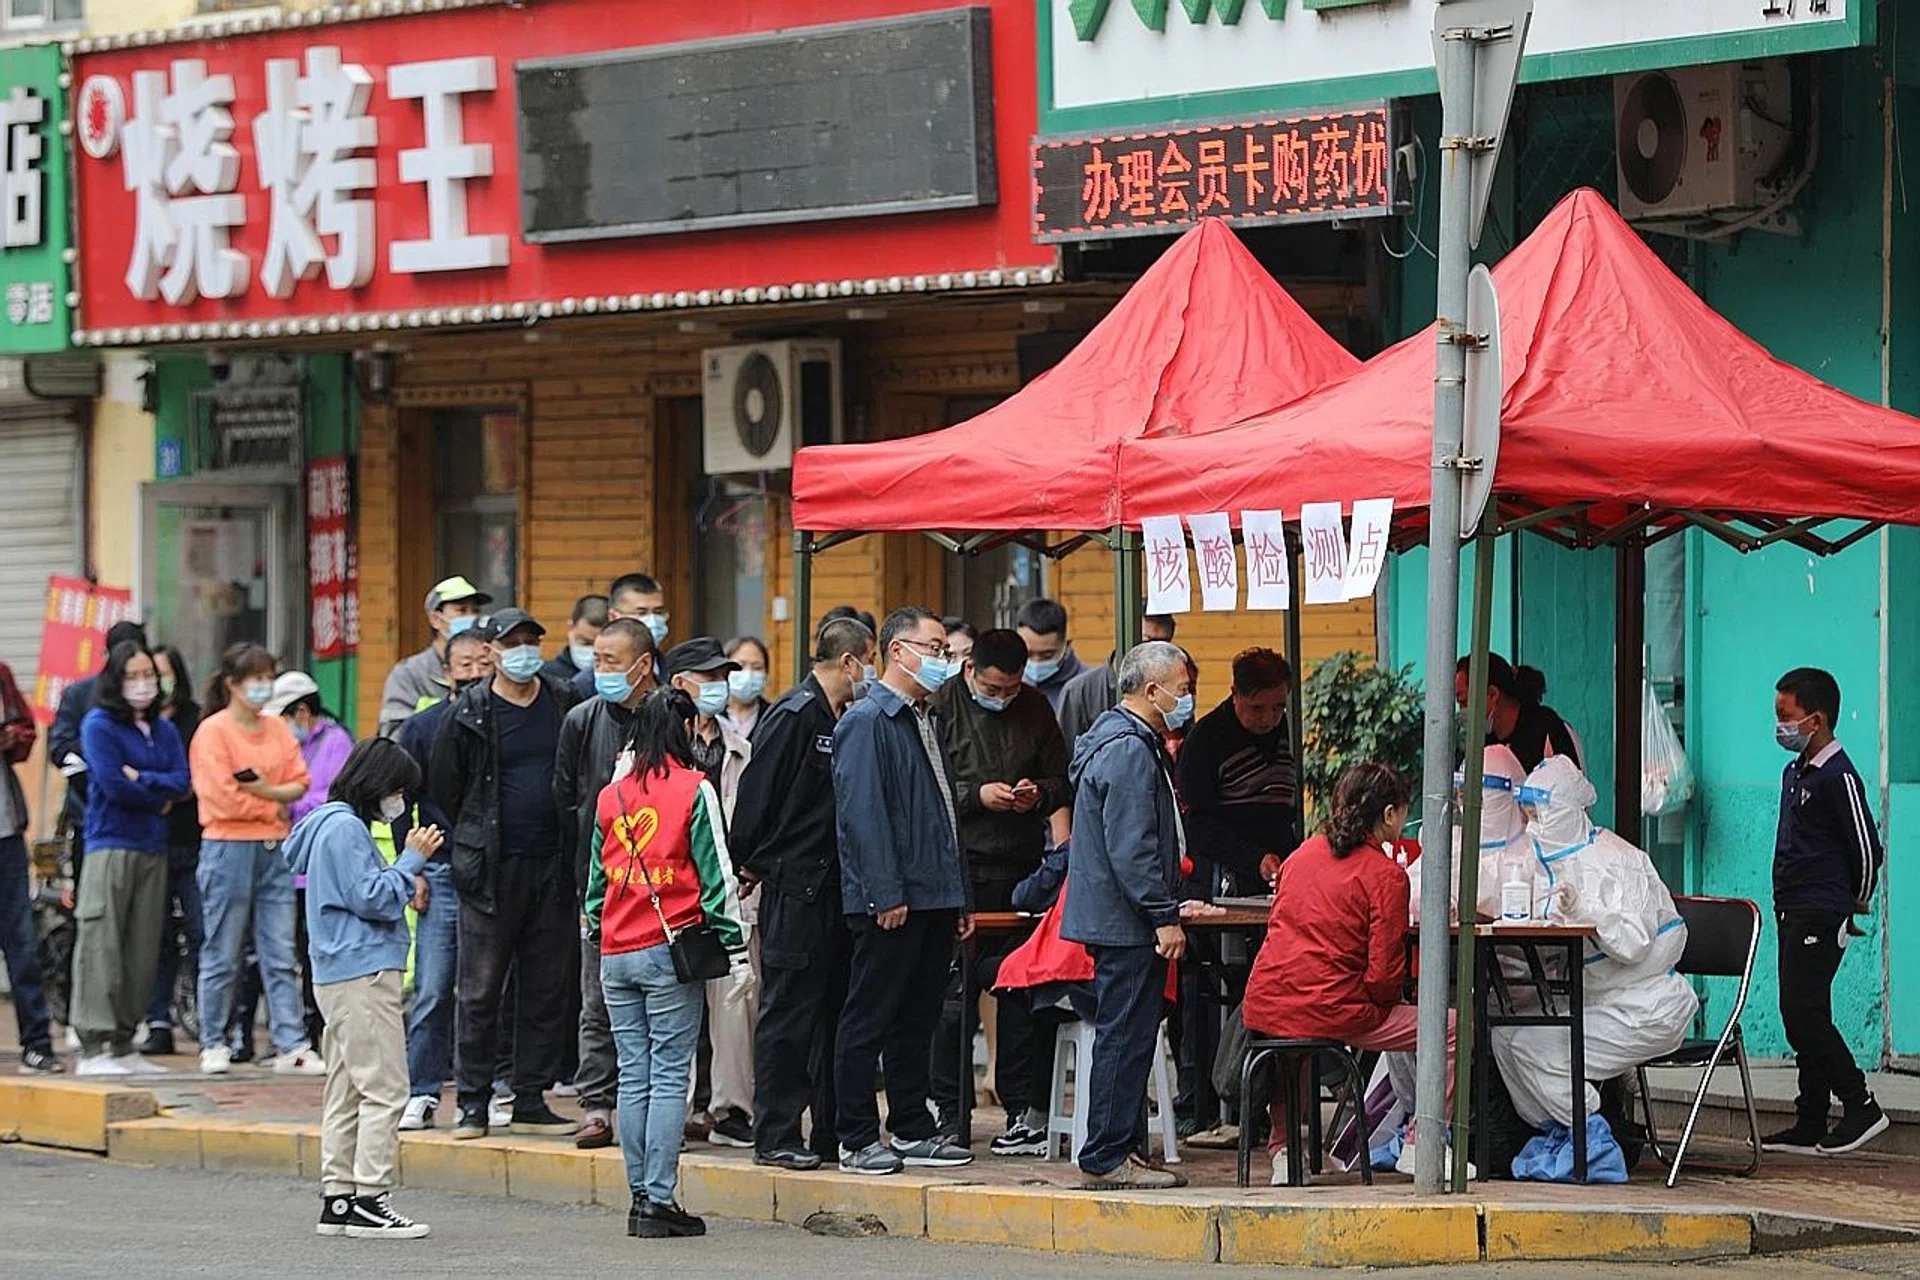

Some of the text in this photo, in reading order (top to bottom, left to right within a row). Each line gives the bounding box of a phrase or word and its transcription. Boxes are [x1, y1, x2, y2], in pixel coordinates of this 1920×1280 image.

[121, 45, 510, 306] 烧烤王
[1082, 121, 1388, 224] 办理会员卡购药优
[1151, 522, 1382, 593] 核酸检测点
